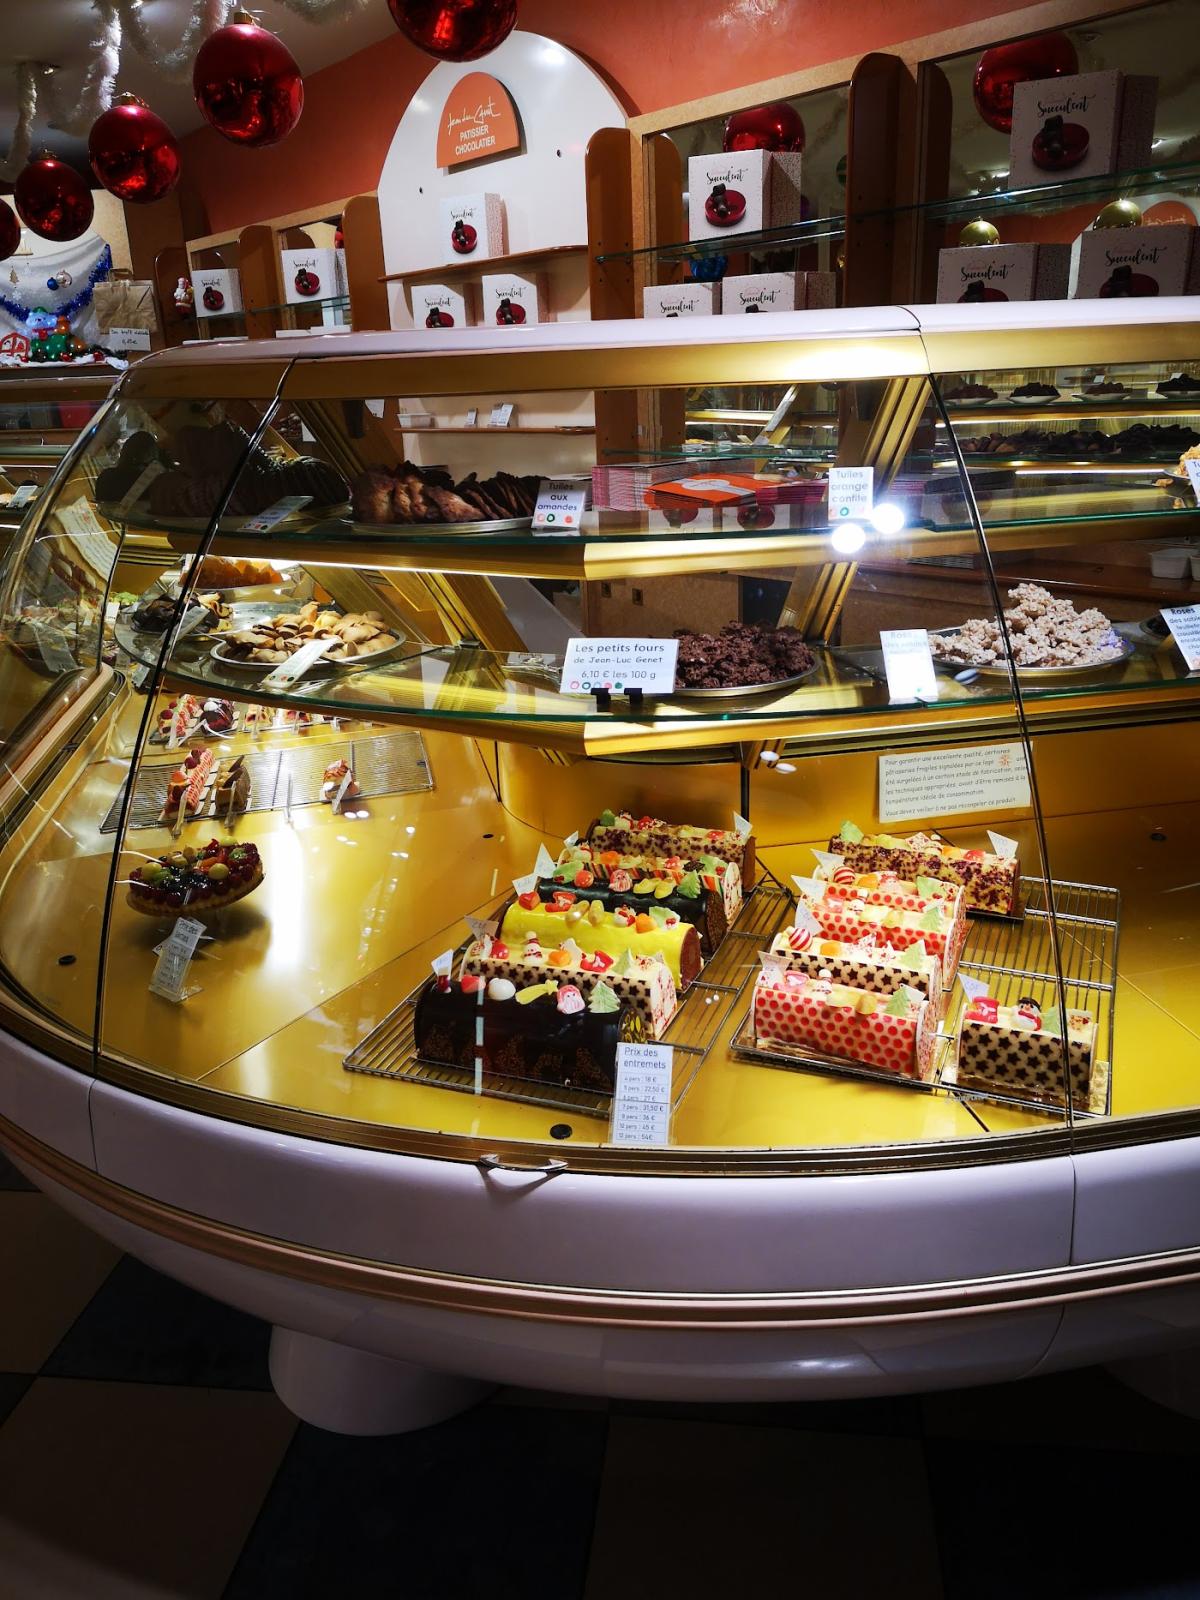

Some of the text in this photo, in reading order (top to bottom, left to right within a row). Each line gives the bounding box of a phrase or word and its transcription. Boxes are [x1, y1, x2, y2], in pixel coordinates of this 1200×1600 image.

[1037, 95, 1096, 116] Succulent
[460, 125, 488, 141] PATISSIER
[456, 136, 495, 156] CHOCOLATIER
[706, 169, 749, 184] Succulent
[1106, 247, 1167, 266] Succulent
[961, 264, 1015, 282] Succulent
[739, 290, 781, 305] Succulent
[660, 300, 699, 313] Succulent
[831, 483, 868, 491] orange
[597, 644, 630, 653] petits
[635, 644, 664, 652] fours
[582, 671, 599, 679] 6,10
[650, 672, 656, 680] g
[624, 1047, 657, 1056] Prix des
[624, 1060, 666, 1069] entremets
